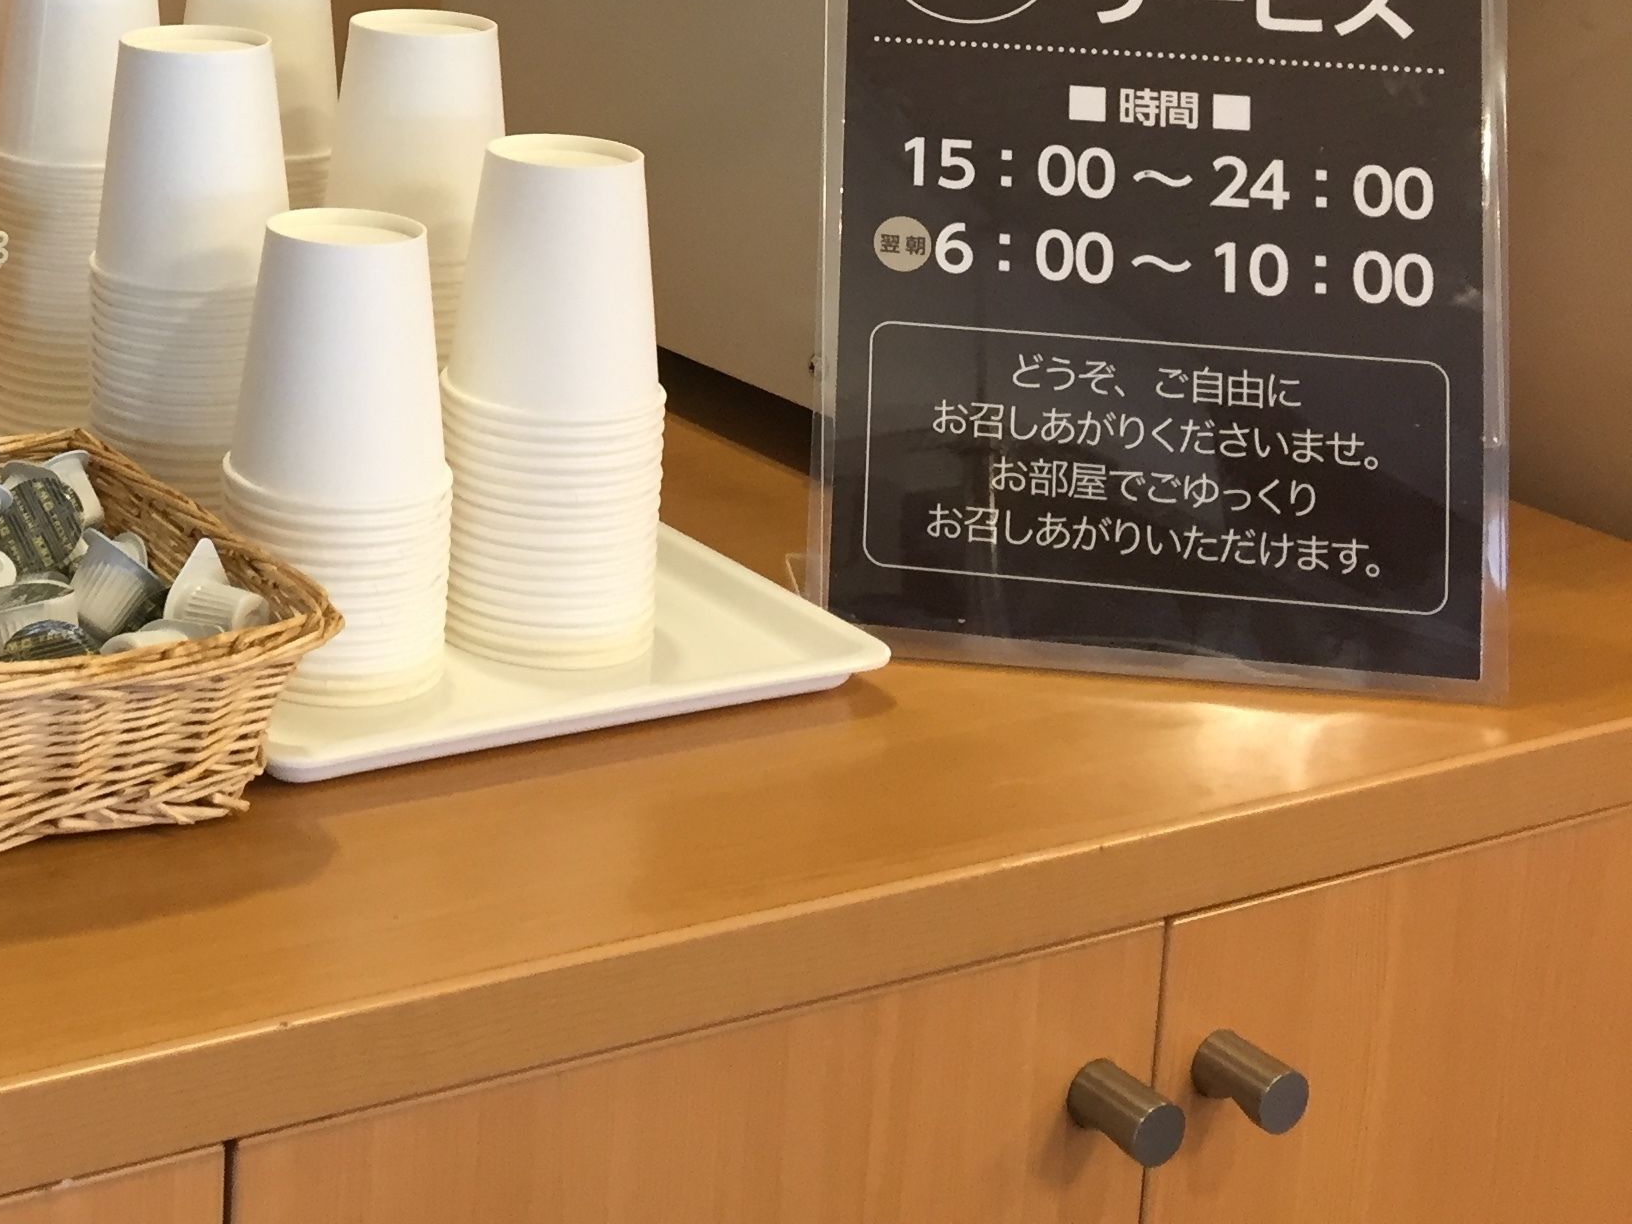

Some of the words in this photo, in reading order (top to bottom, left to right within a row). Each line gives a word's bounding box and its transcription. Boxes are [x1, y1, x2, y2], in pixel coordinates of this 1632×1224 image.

[1118, 87, 1200, 131] 時間
[879, 233, 927, 256] 翌朝
[932, 399, 1380, 471] お召しあがりくださいませ。
[990, 456, 1317, 518] お部屋でごゆっくり
[926, 503, 1382, 579] お召しあがりいただけます。
